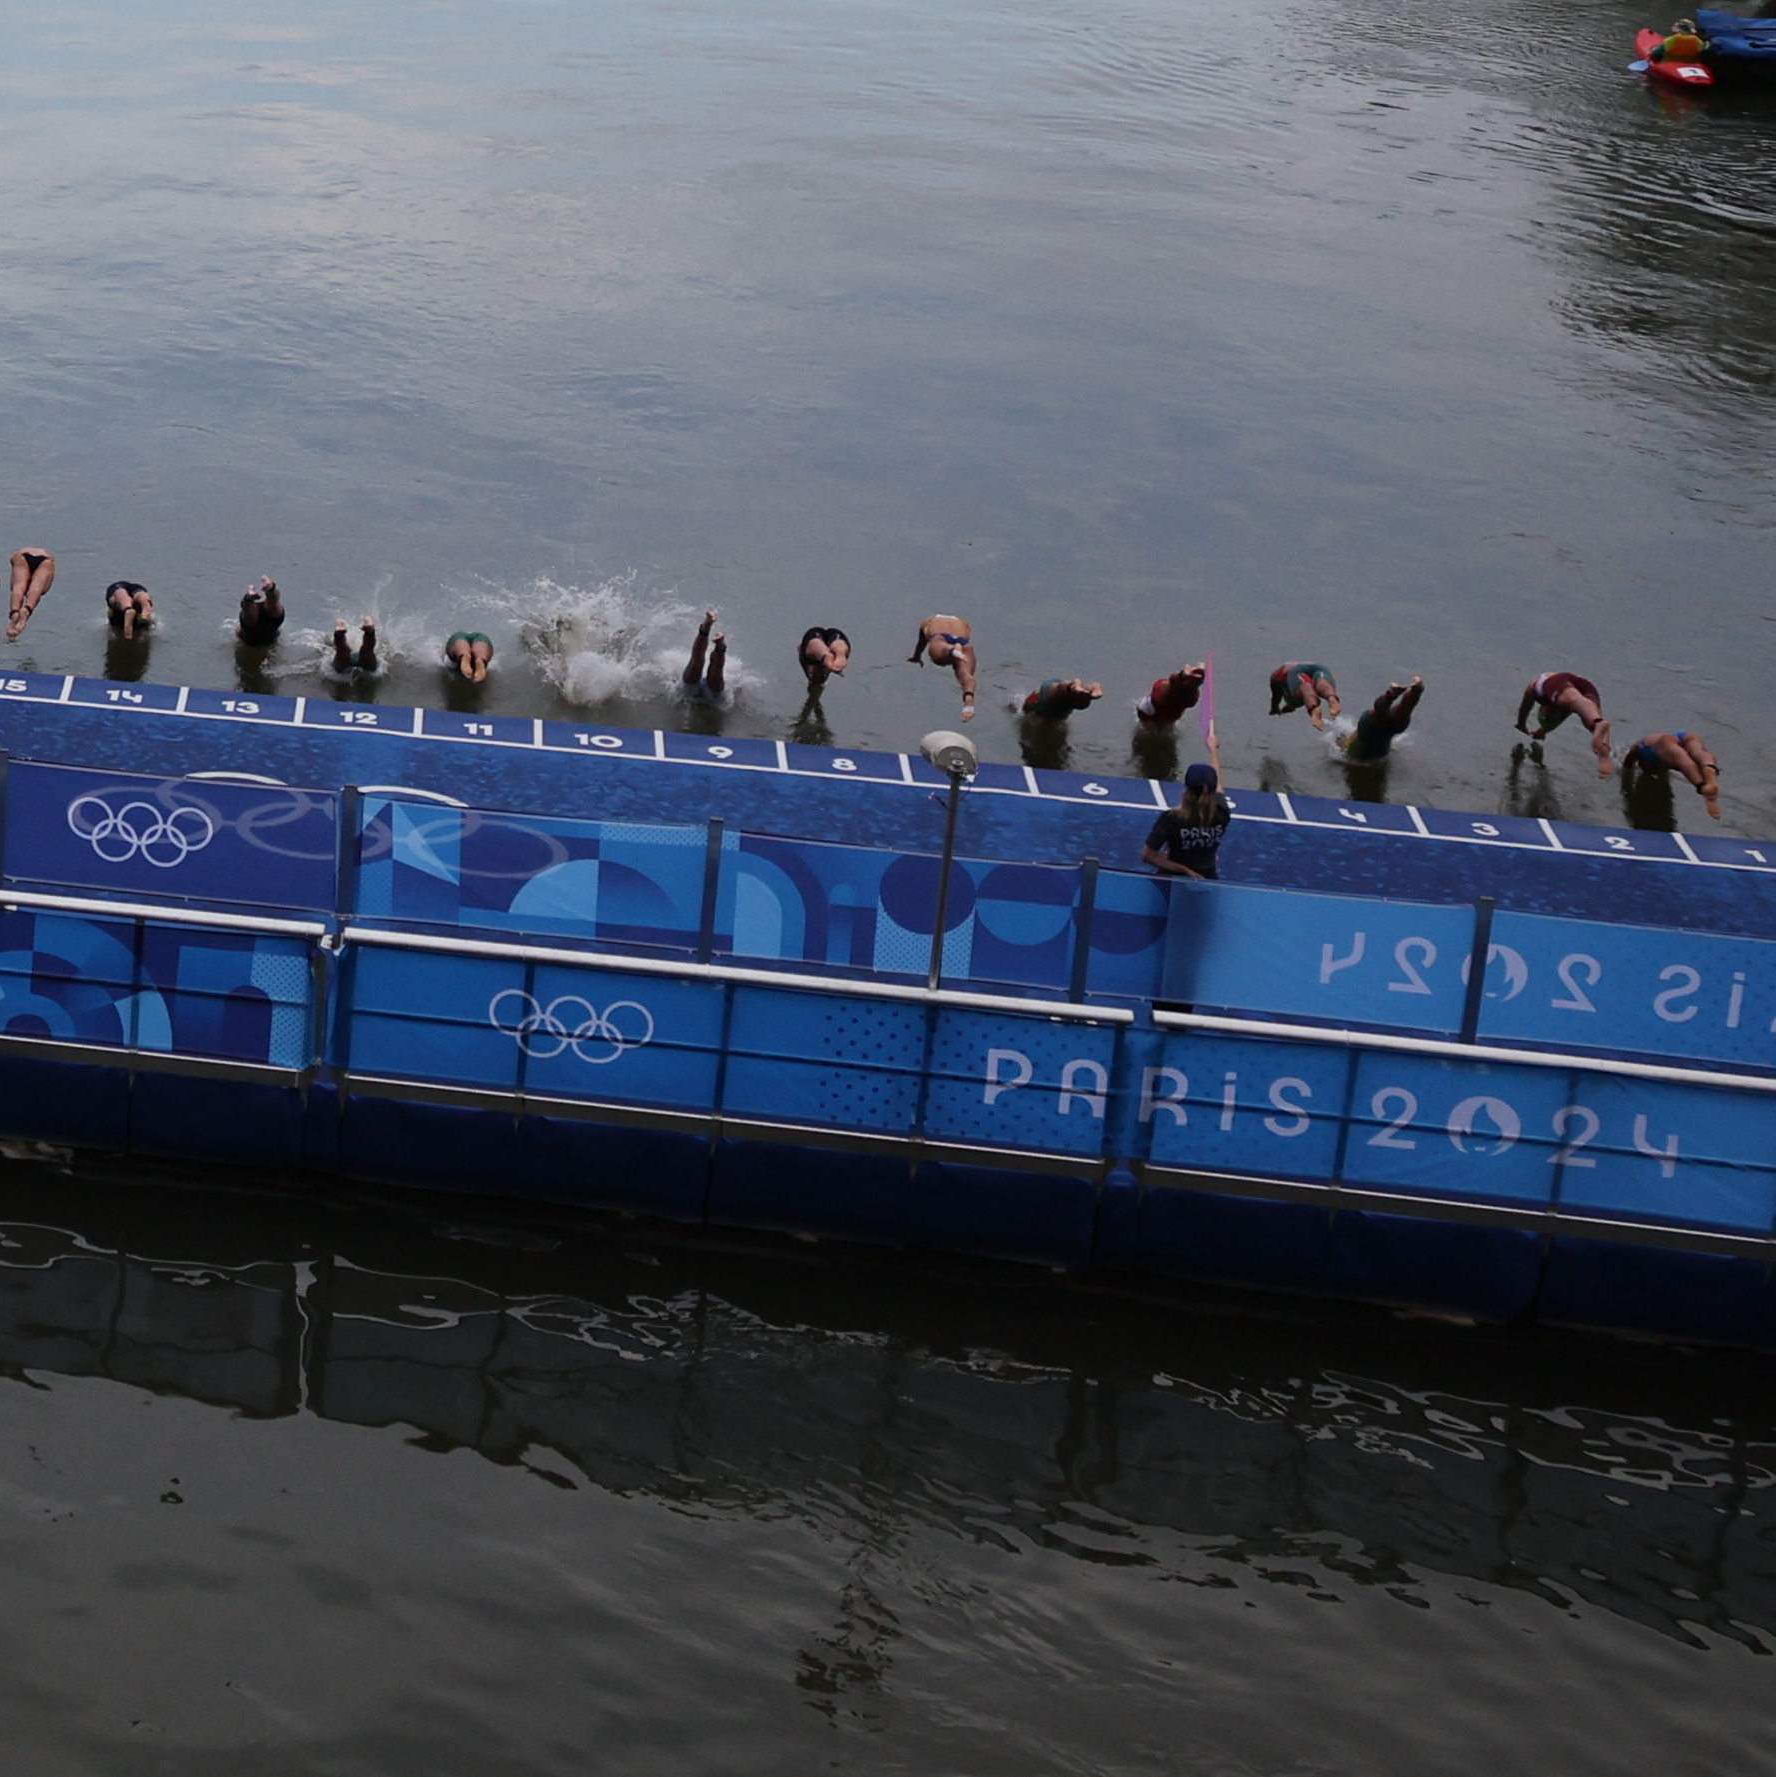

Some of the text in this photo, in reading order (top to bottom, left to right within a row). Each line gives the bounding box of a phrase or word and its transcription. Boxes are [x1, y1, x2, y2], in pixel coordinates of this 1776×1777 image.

[107, 690, 142, 703] 14
[222, 701, 259, 714] 13
[341, 712, 377, 724] 12
[464, 724, 492, 736] 11
[575, 734, 623, 748] 10
[708, 746, 733, 758] 9
[833, 758, 857, 770] 8
[1083, 783, 1108, 795] 6
[1339, 808, 1367, 822] 4
[1472, 823, 1499, 836] 3
[1605, 837, 1635, 850] 2
[1367, 1086, 1679, 1178] 2024
